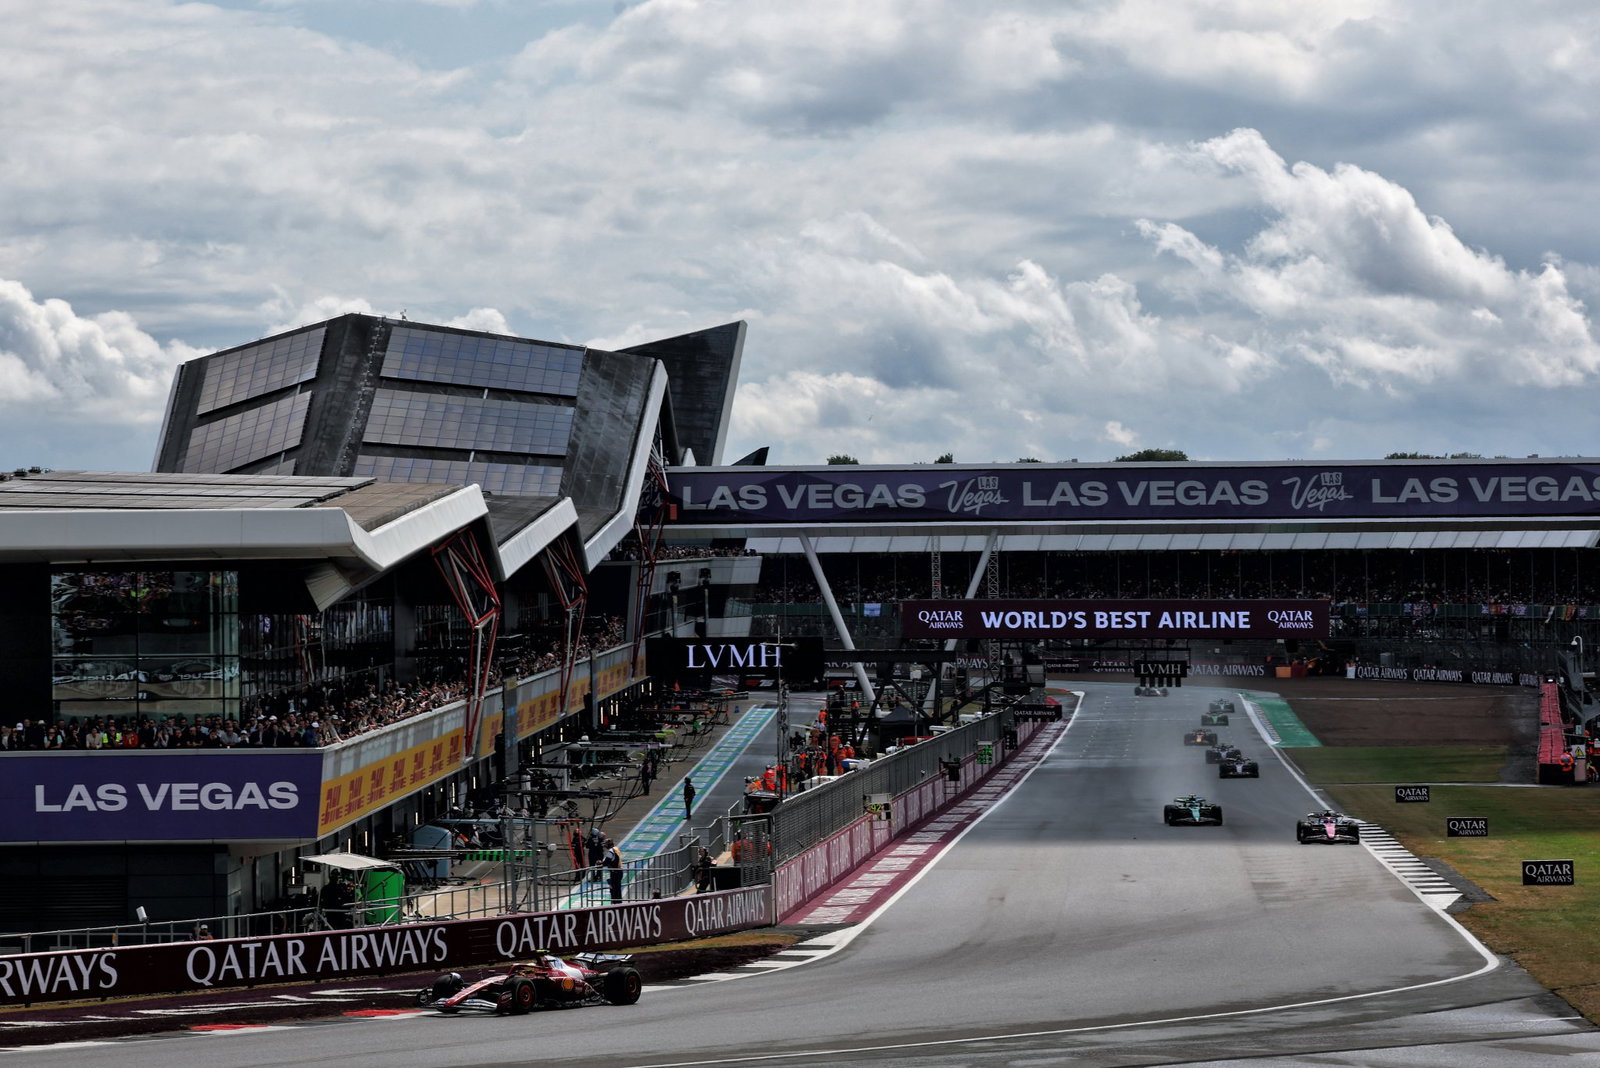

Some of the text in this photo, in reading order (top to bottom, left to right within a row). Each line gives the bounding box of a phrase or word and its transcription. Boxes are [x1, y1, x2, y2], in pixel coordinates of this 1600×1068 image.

[939, 479, 1009, 514] Vegas
[1023, 480, 1269, 506] LAS VEGAS
[1282, 475, 1354, 511] Vegas
[1372, 477, 1600, 503] LAS VEGA
[683, 484, 767, 511] LAS
[776, 483, 926, 510] VEGAS
[918, 610, 963, 623] QATAR
[980, 611, 1251, 629] WORLD'S BEST AIRLINE
[1267, 610, 1313, 623] QATAR
[929, 621, 964, 629] AIRWAYS
[1278, 621, 1314, 629] AIRWAYS
[686, 643, 783, 668] LVMH
[1140, 663, 1182, 675] LVMH
[1222, 664, 1265, 676] AIRWAYS
[1357, 666, 1380, 679] QATAR
[1413, 669, 1436, 681] QATAR
[35, 781, 299, 812] LAS VEGAS
[1396, 787, 1428, 797] QATAR
[1448, 820, 1486, 831] QATAR
[1525, 864, 1572, 877] QATAR
[1536, 875, 1572, 883] AIRWAYS
[685, 897, 725, 936] QATAR
[726, 889, 765, 926] AIRWAYS
[496, 905, 661, 958] QATAR AIRWAYS
[186, 927, 448, 987] QATAR AIRWAYS
